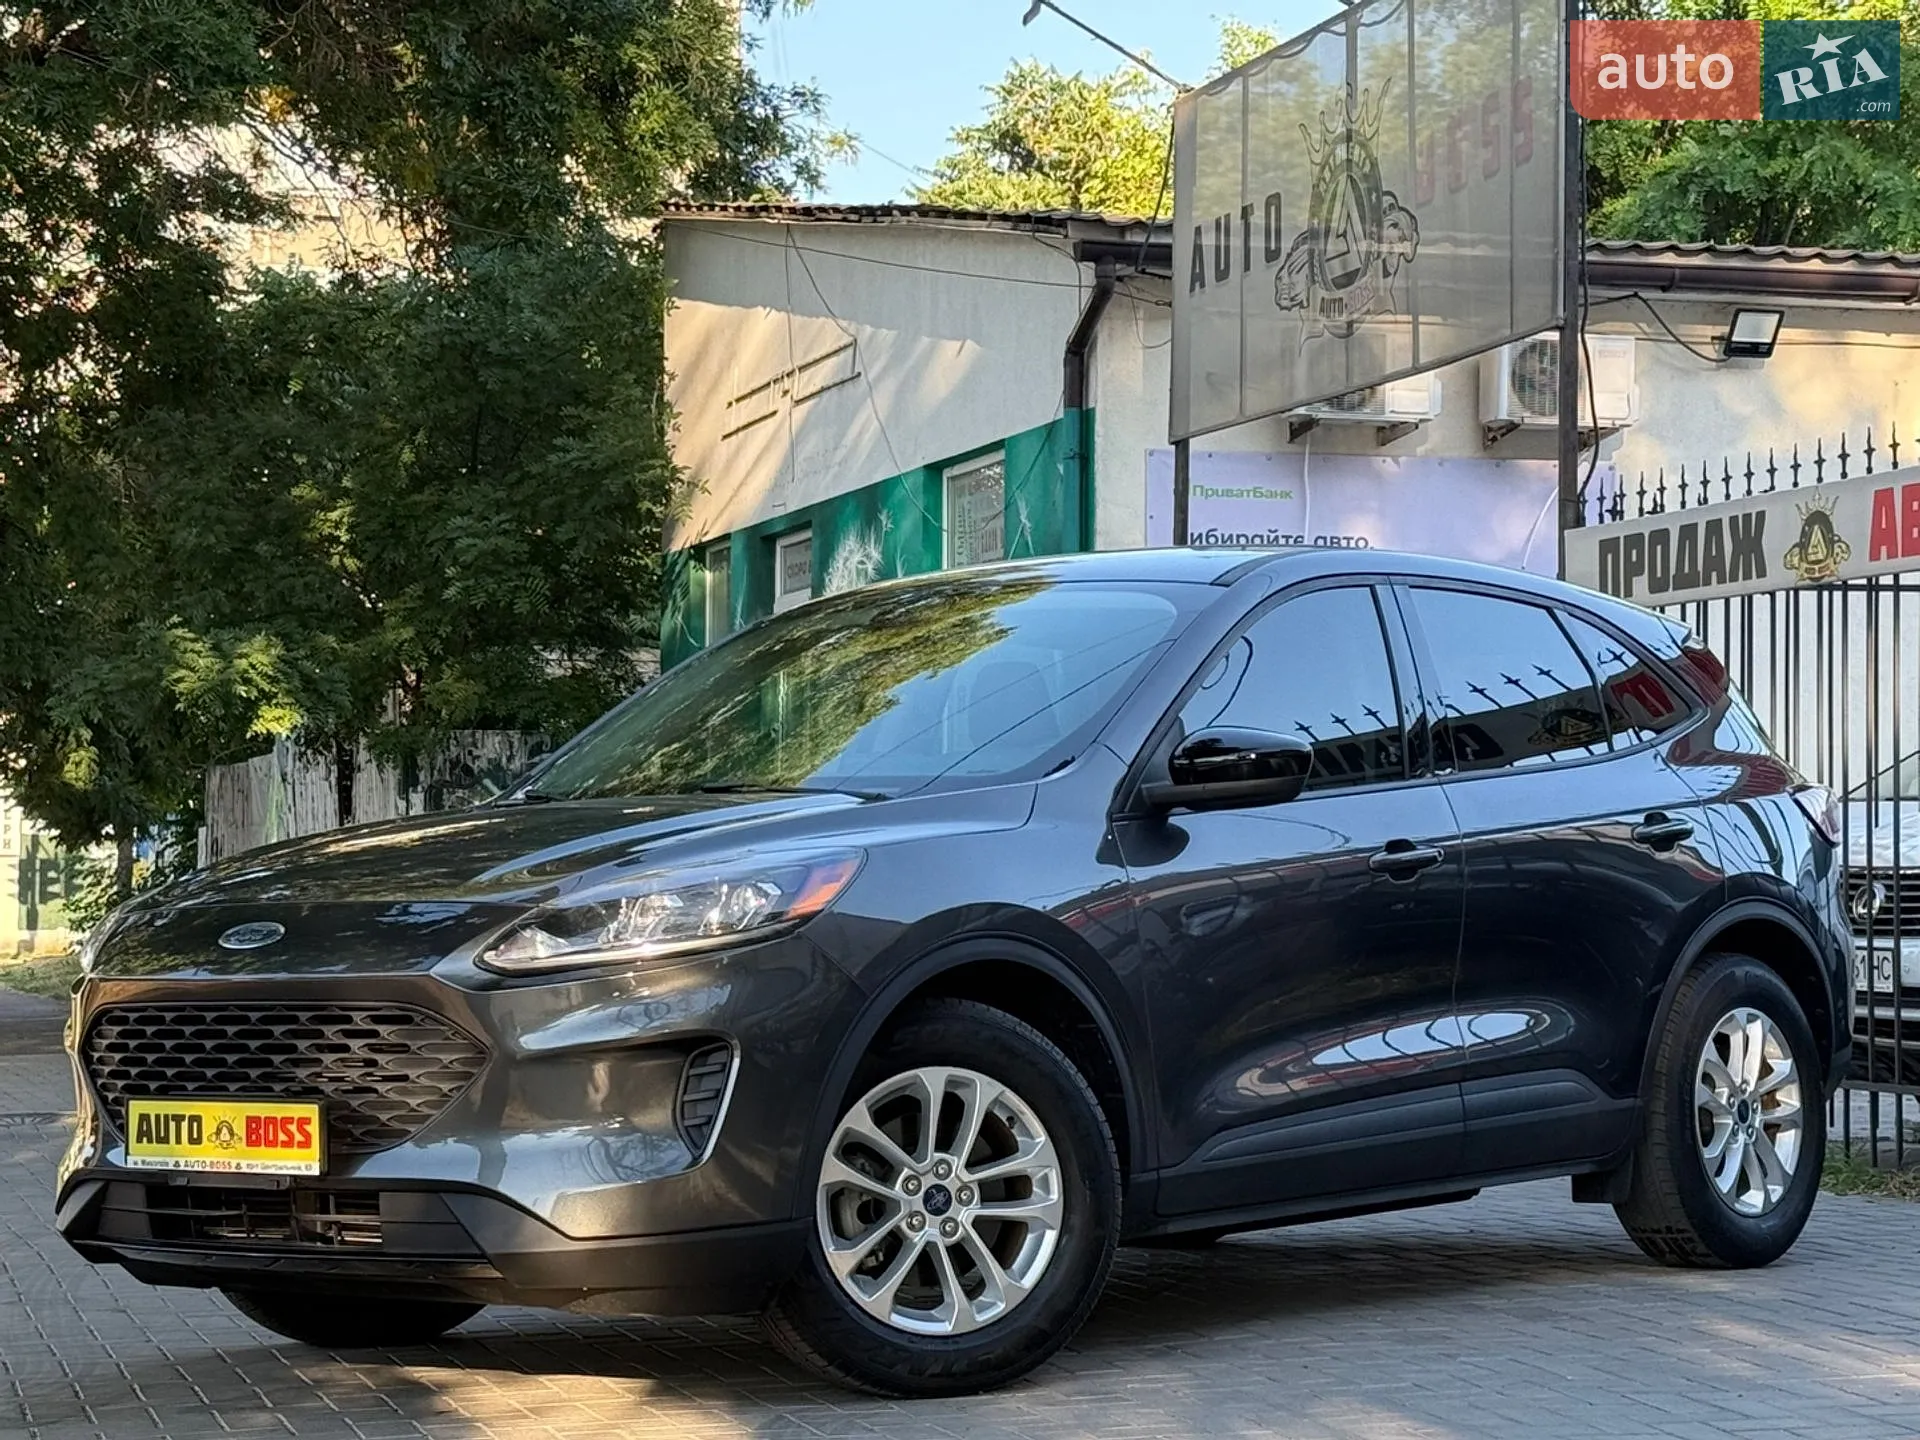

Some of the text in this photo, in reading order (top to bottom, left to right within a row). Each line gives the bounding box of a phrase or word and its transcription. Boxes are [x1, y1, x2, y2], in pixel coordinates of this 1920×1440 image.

[1189, 191, 1283, 294] AUTO
[1192, 484, 1294, 500] ПриватБанк
[1189, 527, 1305, 546] ибирайте
[1597, 509, 1768, 600] ПРОДАЖ
[135, 1113, 313, 1149] AUTO BOSS
